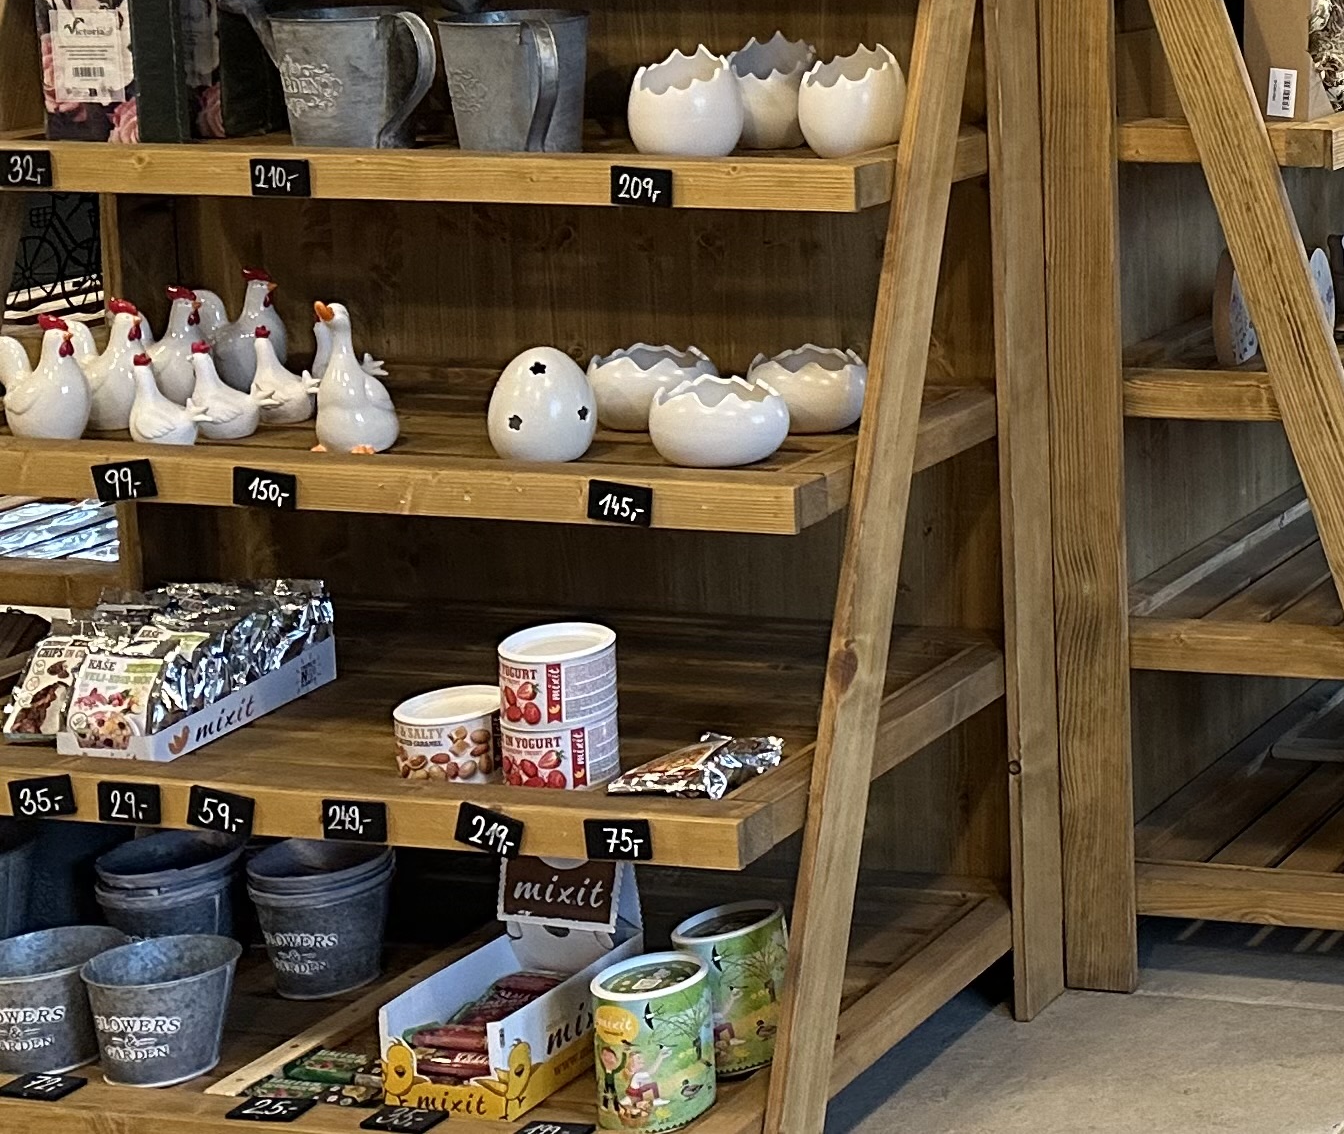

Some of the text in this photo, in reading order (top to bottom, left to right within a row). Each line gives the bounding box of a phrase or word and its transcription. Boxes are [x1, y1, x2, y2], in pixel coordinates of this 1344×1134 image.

[7, 155, 46, 184] 32,-
[254, 164, 300, 192] 210,-
[104, 466, 142, 499] 99,-
[246, 476, 291, 507] 150,-
[598, 494, 645, 522] 145,-
[88, 656, 117, 672] KAŠE
[548, 666, 561, 702] mixit
[194, 696, 256, 743] mixit
[406, 726, 445, 740] SALTY
[515, 736, 562, 750] YOGURT
[573, 732, 585, 766] mixit
[19, 787, 64, 815] 35,-
[110, 789, 149, 820] 29,-
[198, 797, 245, 833] 59,-
[467, 814, 516, 856] 219,-
[602, 827, 644, 858] 75,-
[513, 875, 605, 908] mixit
[105, 1044, 170, 1062] GARDEN
[417, 1091, 487, 1116] mixit
